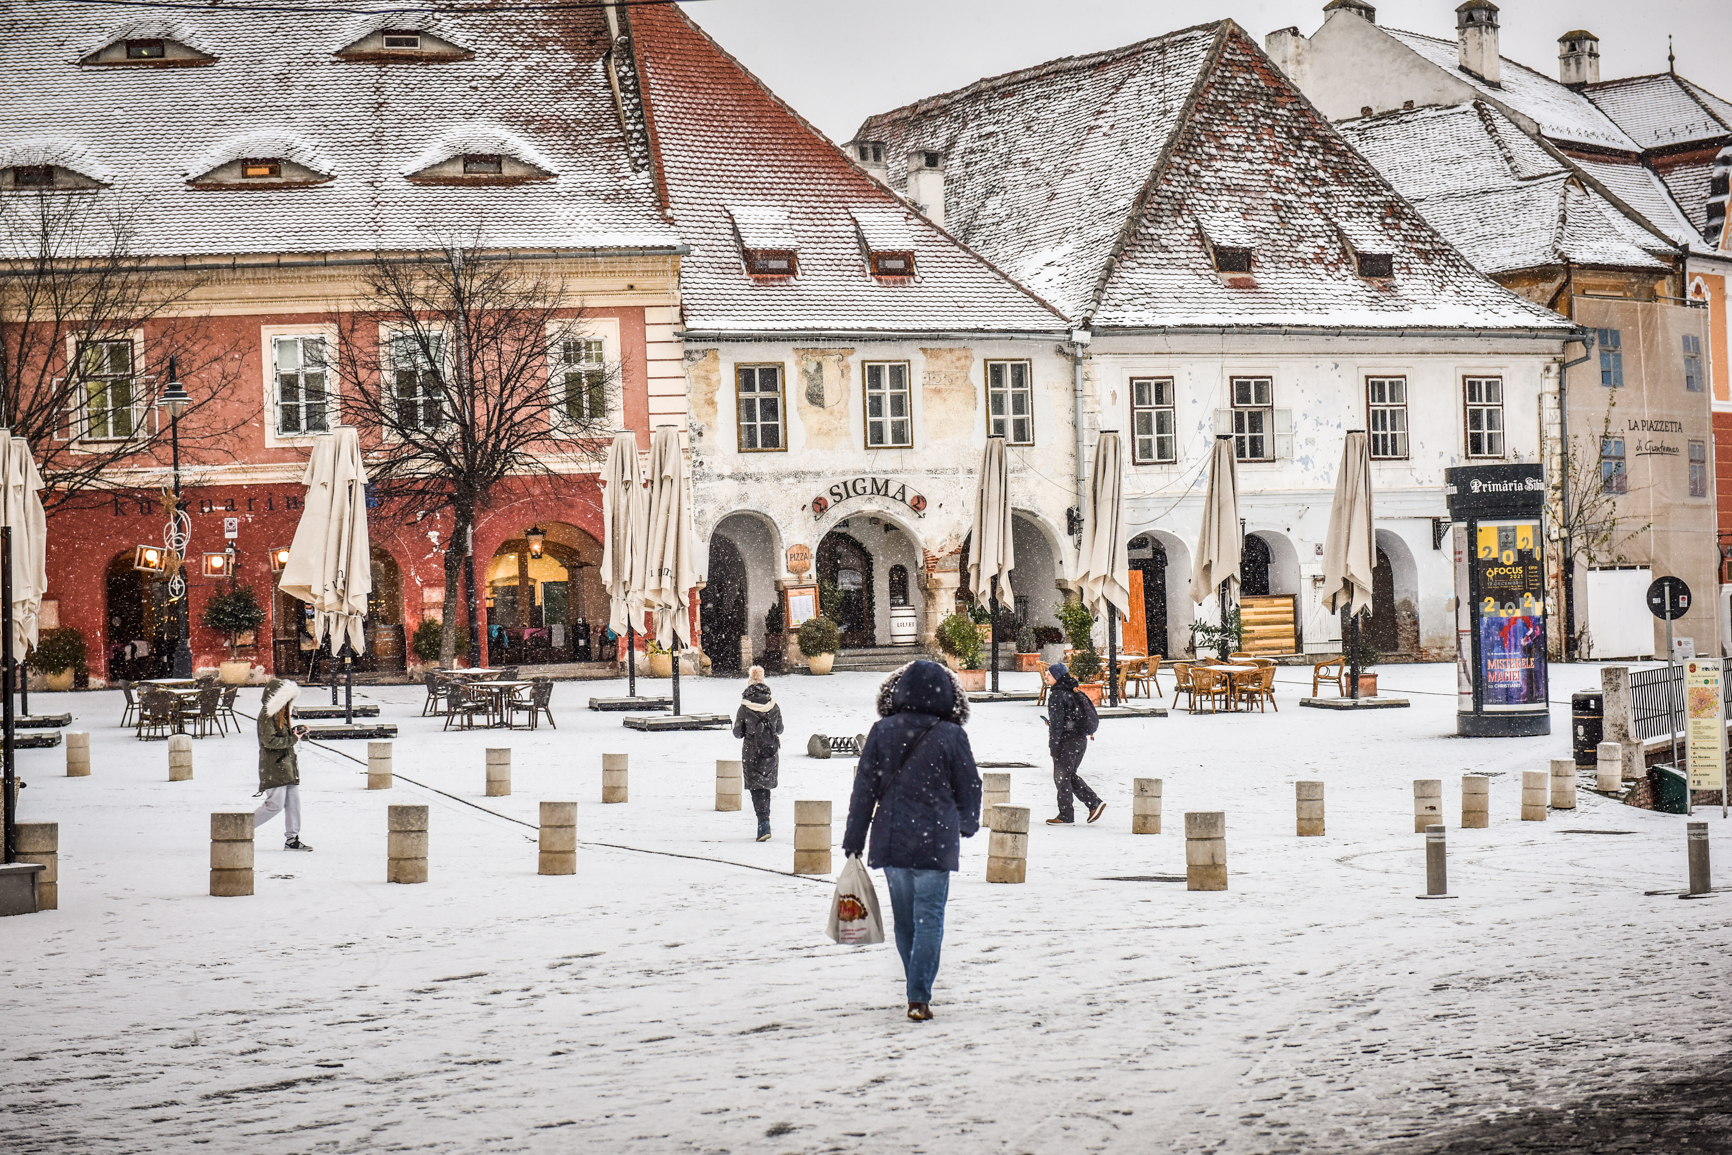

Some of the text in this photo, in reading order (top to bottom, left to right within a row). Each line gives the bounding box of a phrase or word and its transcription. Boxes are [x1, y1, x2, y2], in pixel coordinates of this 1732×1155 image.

[1628, 419, 1683, 433] LA PIAZZETTA
[829, 477, 907, 503] SIGMA
[789, 552, 808, 562] PIZZA
[1494, 566, 1523, 575] FOCUS
[1487, 657, 1535, 670] MISTERELE
[1487, 671, 1520, 682] MAGIEI
